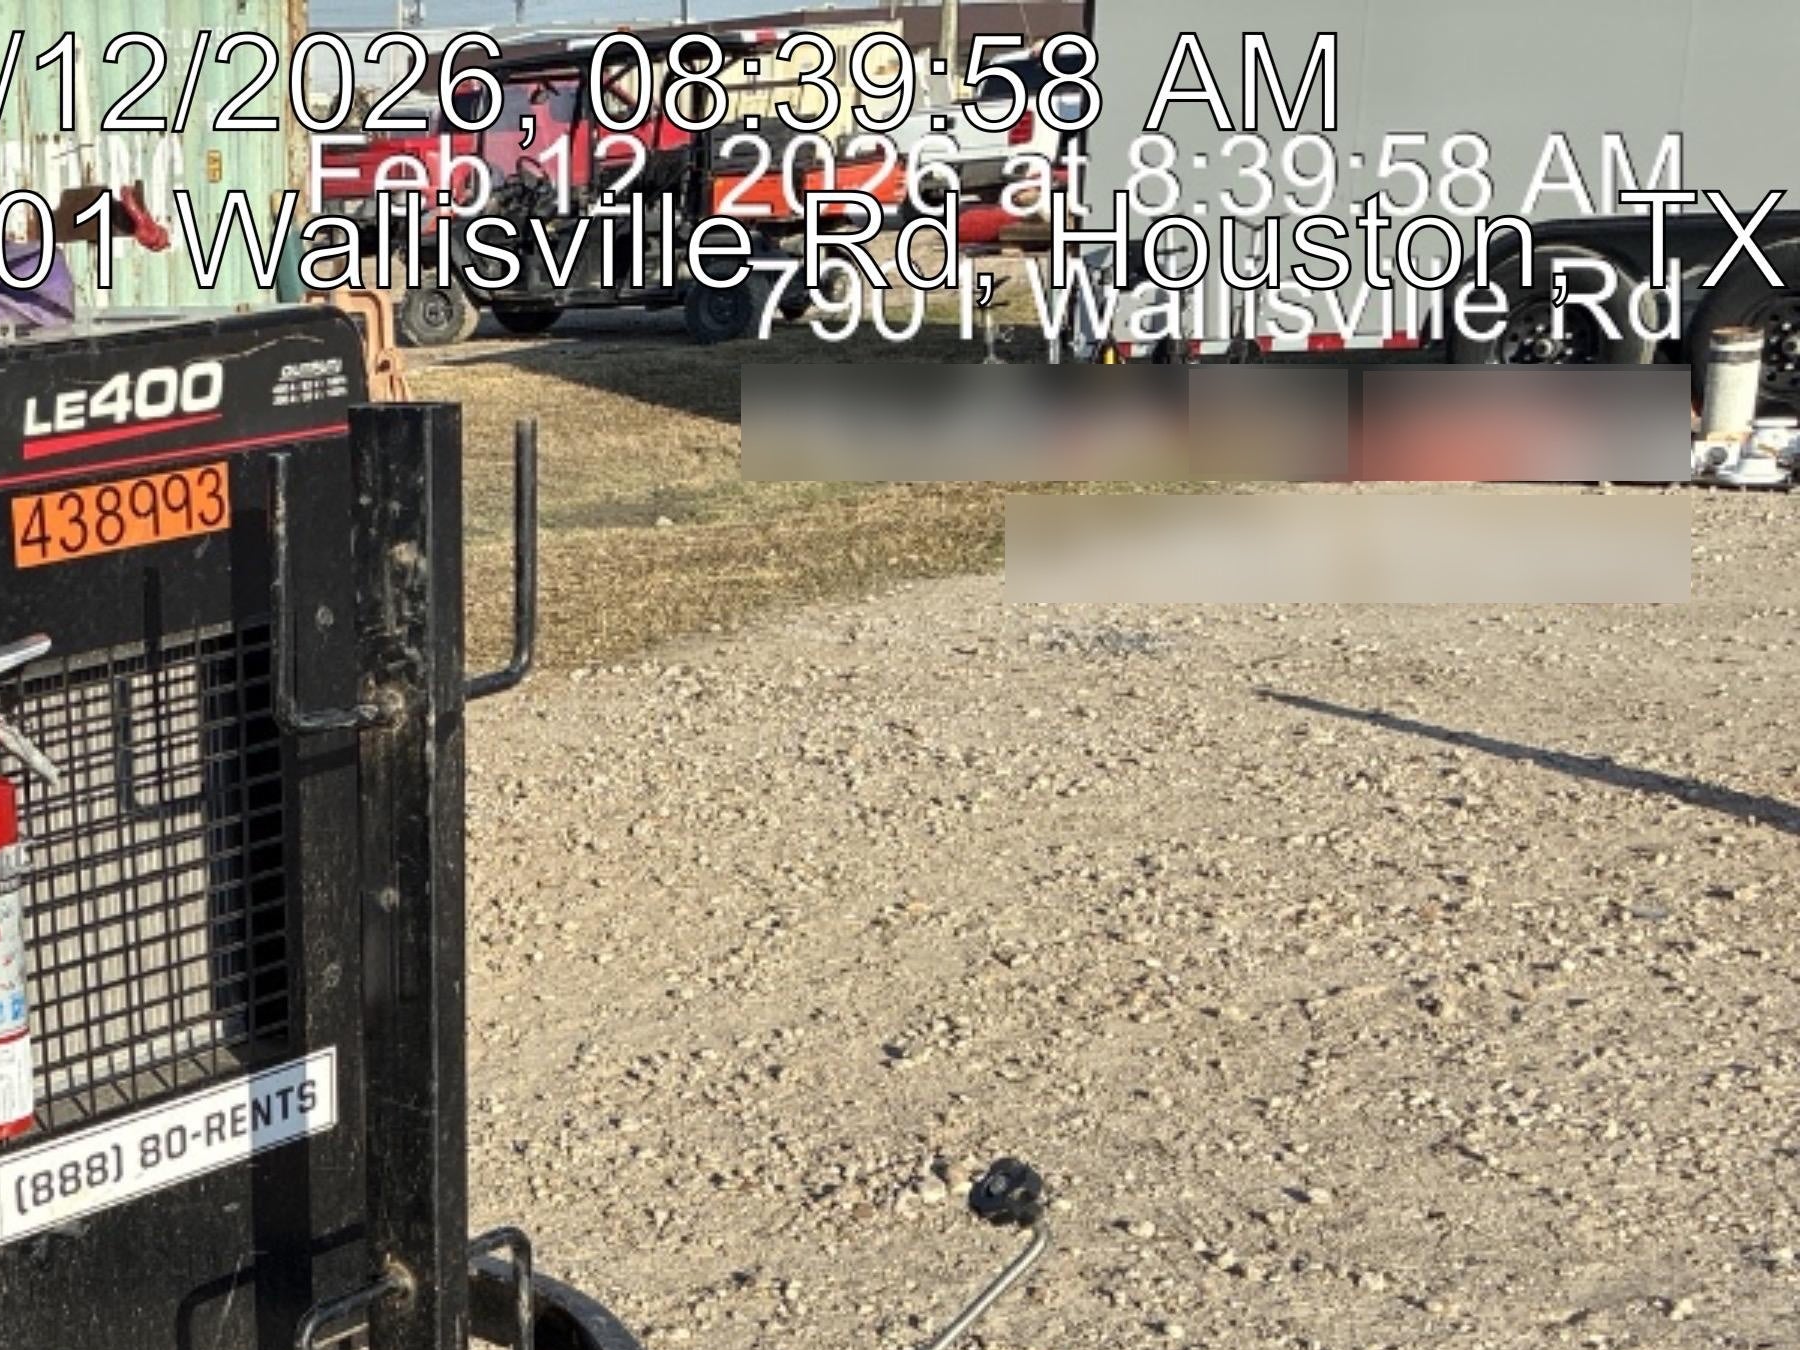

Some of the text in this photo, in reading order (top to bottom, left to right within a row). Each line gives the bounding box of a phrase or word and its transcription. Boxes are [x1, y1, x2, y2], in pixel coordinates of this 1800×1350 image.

[23, 360, 225, 437] LE400
[20, 465, 228, 558] 438993
[13, 1079, 318, 1214] (888) 80-RENTS
